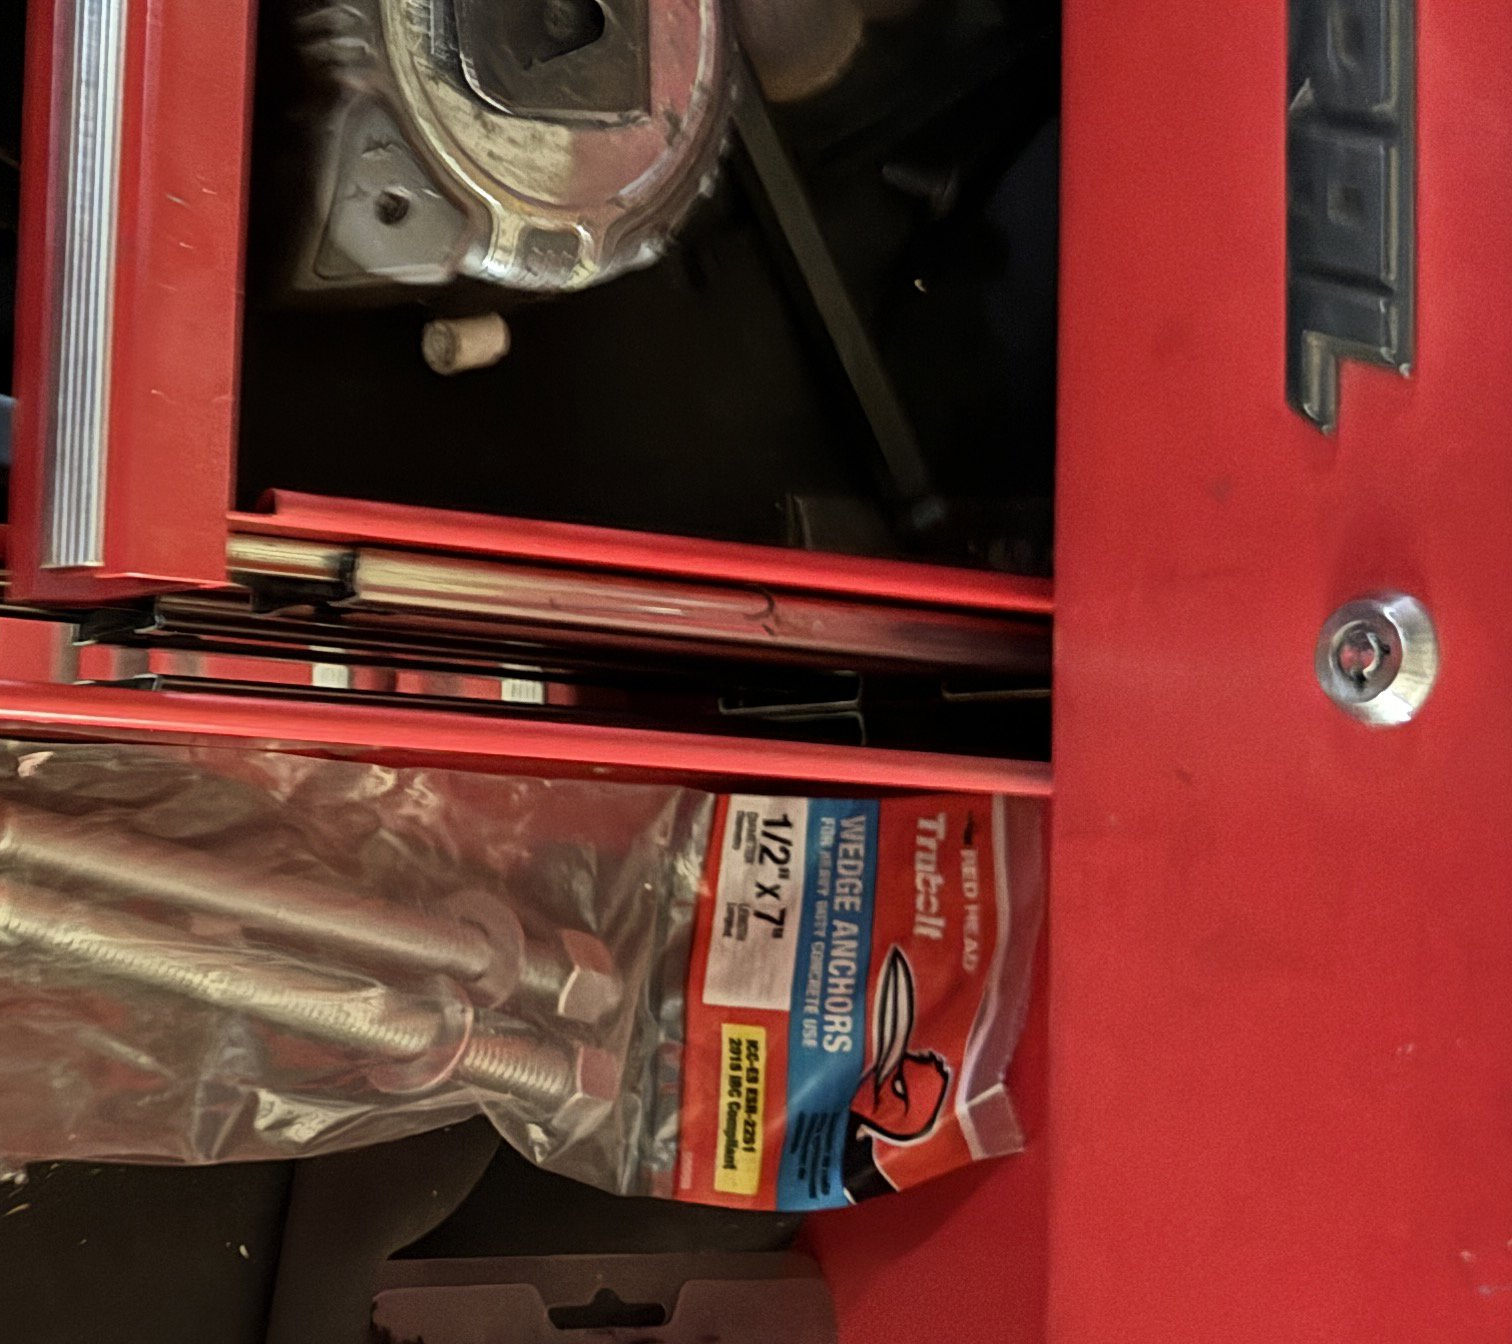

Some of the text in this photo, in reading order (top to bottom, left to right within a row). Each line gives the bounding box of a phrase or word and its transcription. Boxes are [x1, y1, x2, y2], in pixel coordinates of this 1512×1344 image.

[759, 814, 794, 880] 1/2"
[819, 816, 835, 847] FOR
[912, 812, 947, 940] Trubolt
[753, 907, 786, 940] 7"
[822, 814, 866, 1053] WEDGE ANCHORS
[960, 849, 980, 973] RED HEAD
[801, 1018, 818, 1049] USE
